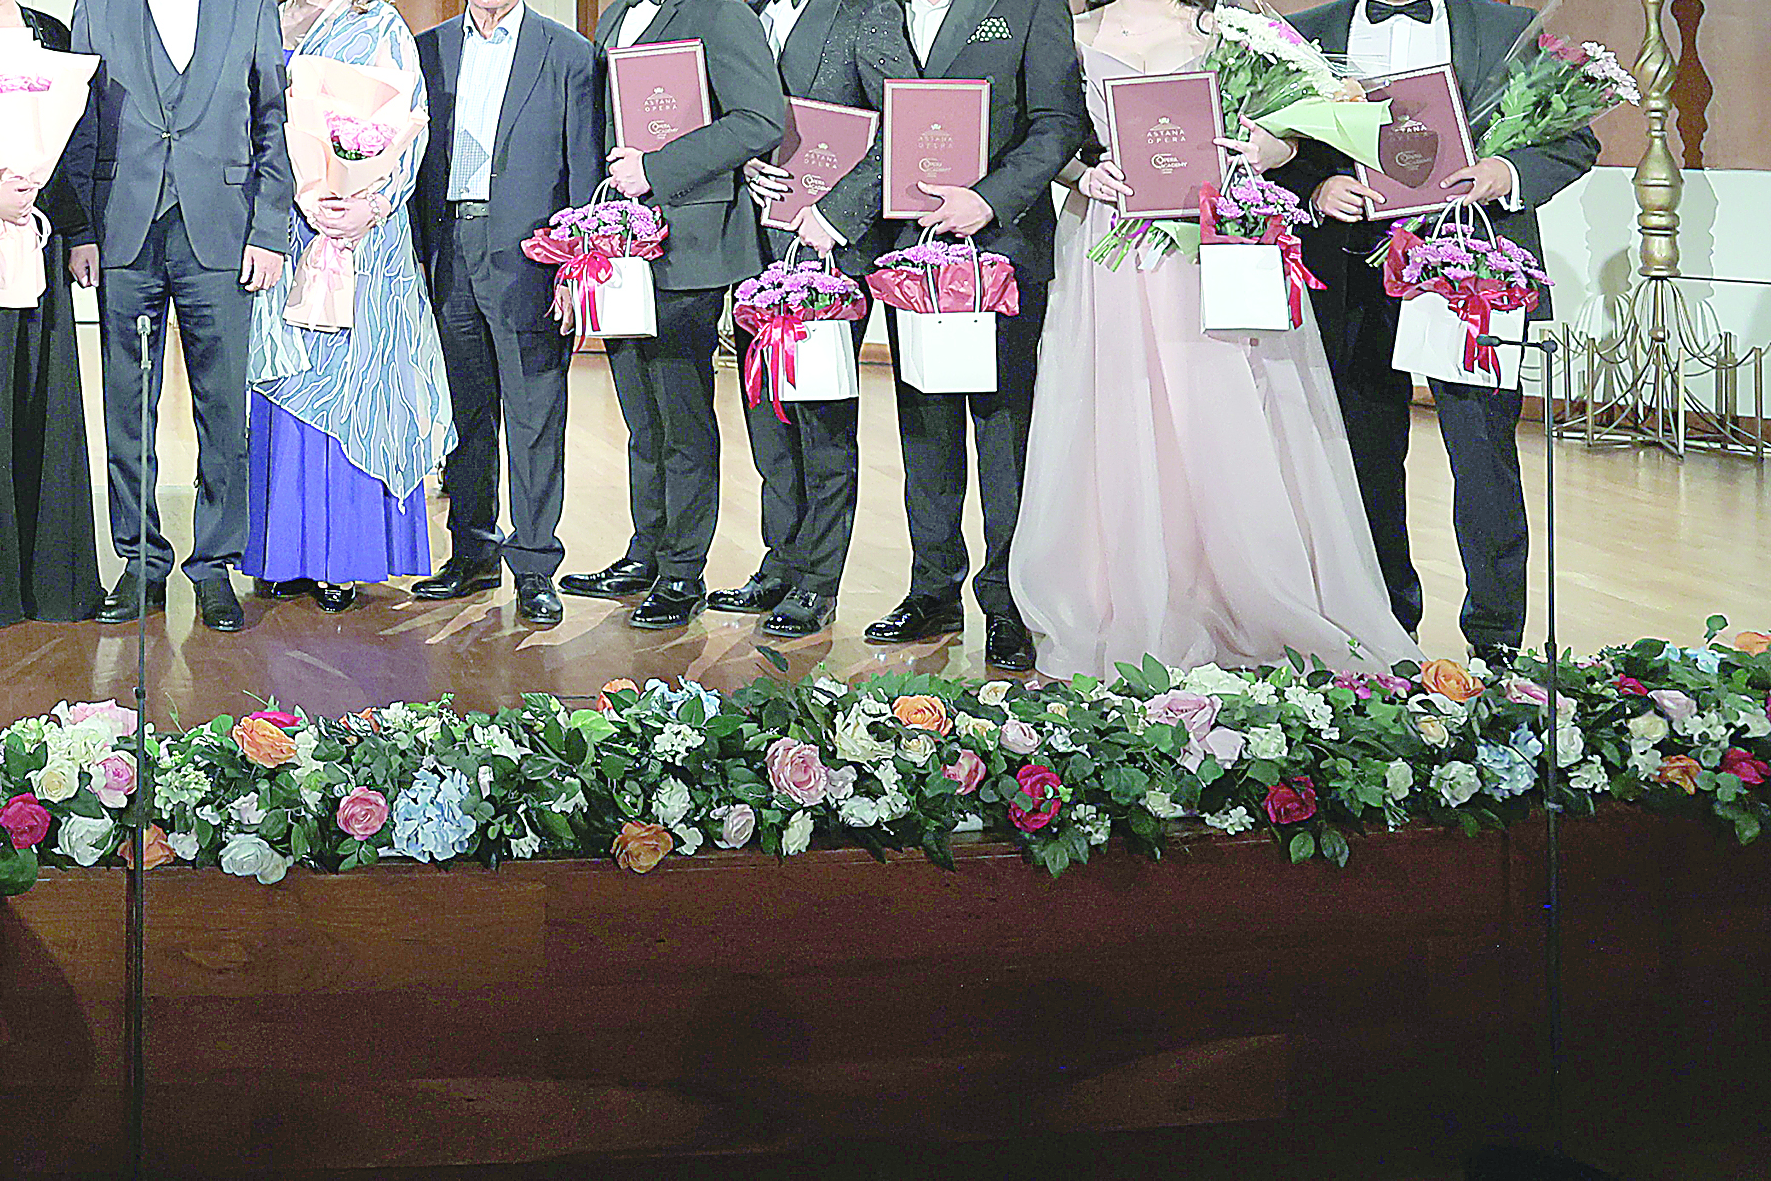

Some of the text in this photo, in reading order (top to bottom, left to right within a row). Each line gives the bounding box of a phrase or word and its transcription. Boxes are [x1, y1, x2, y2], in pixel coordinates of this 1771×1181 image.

[643, 97, 677, 106] ASTANA
[644, 104, 678, 112] OPERA
[1146, 129, 1185, 137] ASTANA
[1147, 136, 1186, 144] OPERA
